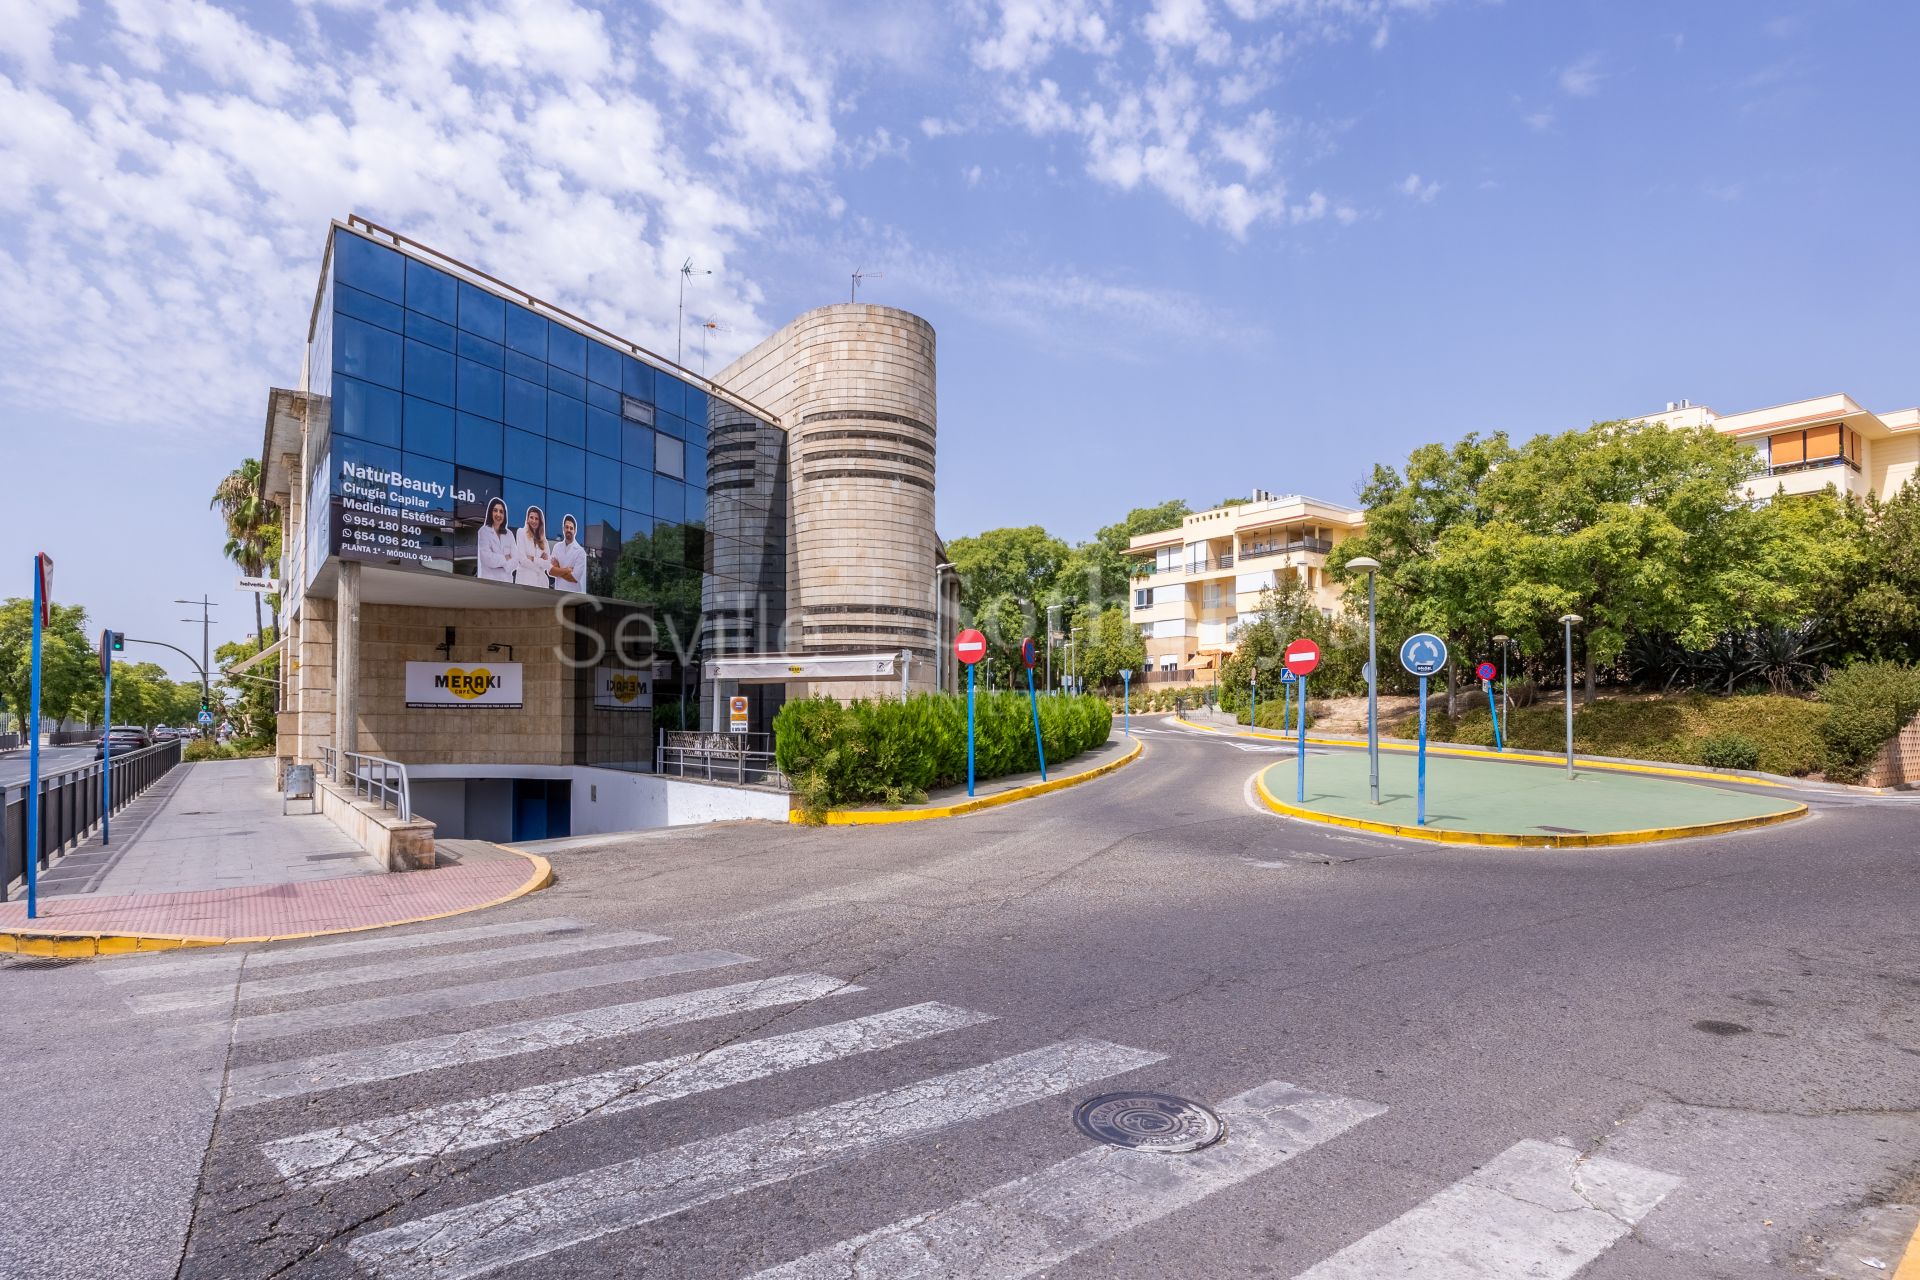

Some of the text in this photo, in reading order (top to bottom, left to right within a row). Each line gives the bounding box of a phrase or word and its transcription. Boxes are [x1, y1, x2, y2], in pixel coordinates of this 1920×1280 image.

[343, 460, 476, 504] NaturBeauty Lab
[343, 481, 430, 509] Cirugía Capilar
[342, 497, 446, 527] Medicina Estética
[353, 515, 422, 536] 954 180 840
[353, 530, 421, 550] 654 096 201
[341, 543, 371, 554] PLANTA
[386, 548, 418, 560] MÓDULO
[418, 554, 433, 562] 42A
[434, 675, 502, 693] MERAKI
